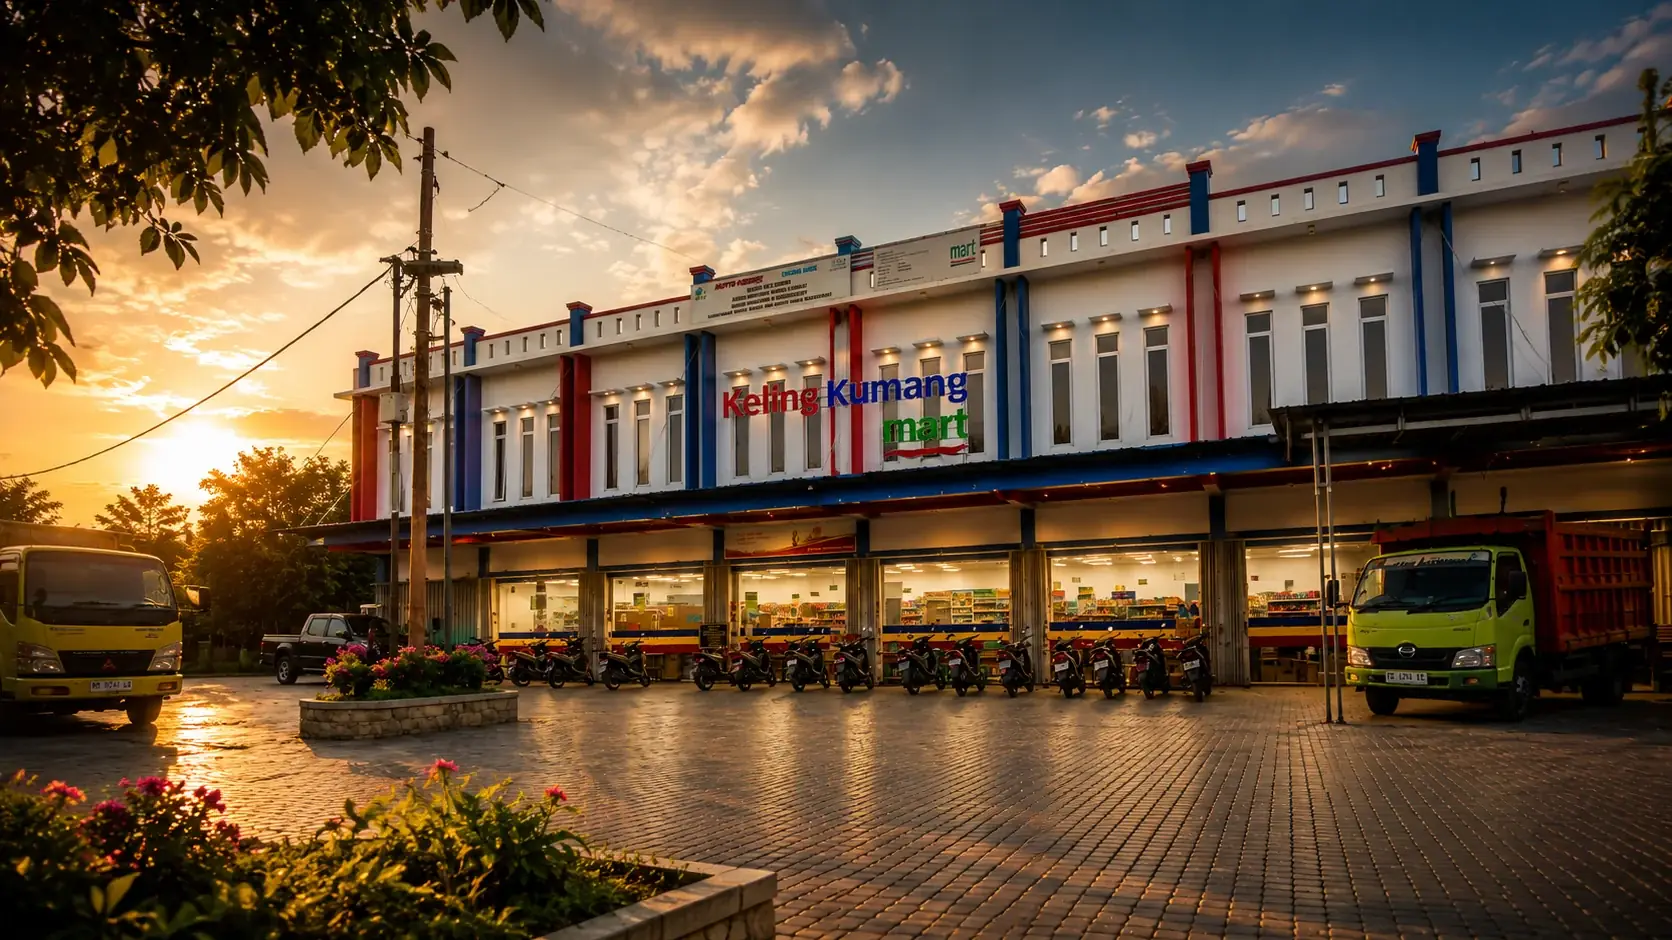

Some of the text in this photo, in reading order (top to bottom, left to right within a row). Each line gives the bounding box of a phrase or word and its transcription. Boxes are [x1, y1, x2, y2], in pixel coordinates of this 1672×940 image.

[950, 239, 976, 259] mart
[723, 372, 968, 418] Keling Kumang
[884, 408, 968, 443] mart
